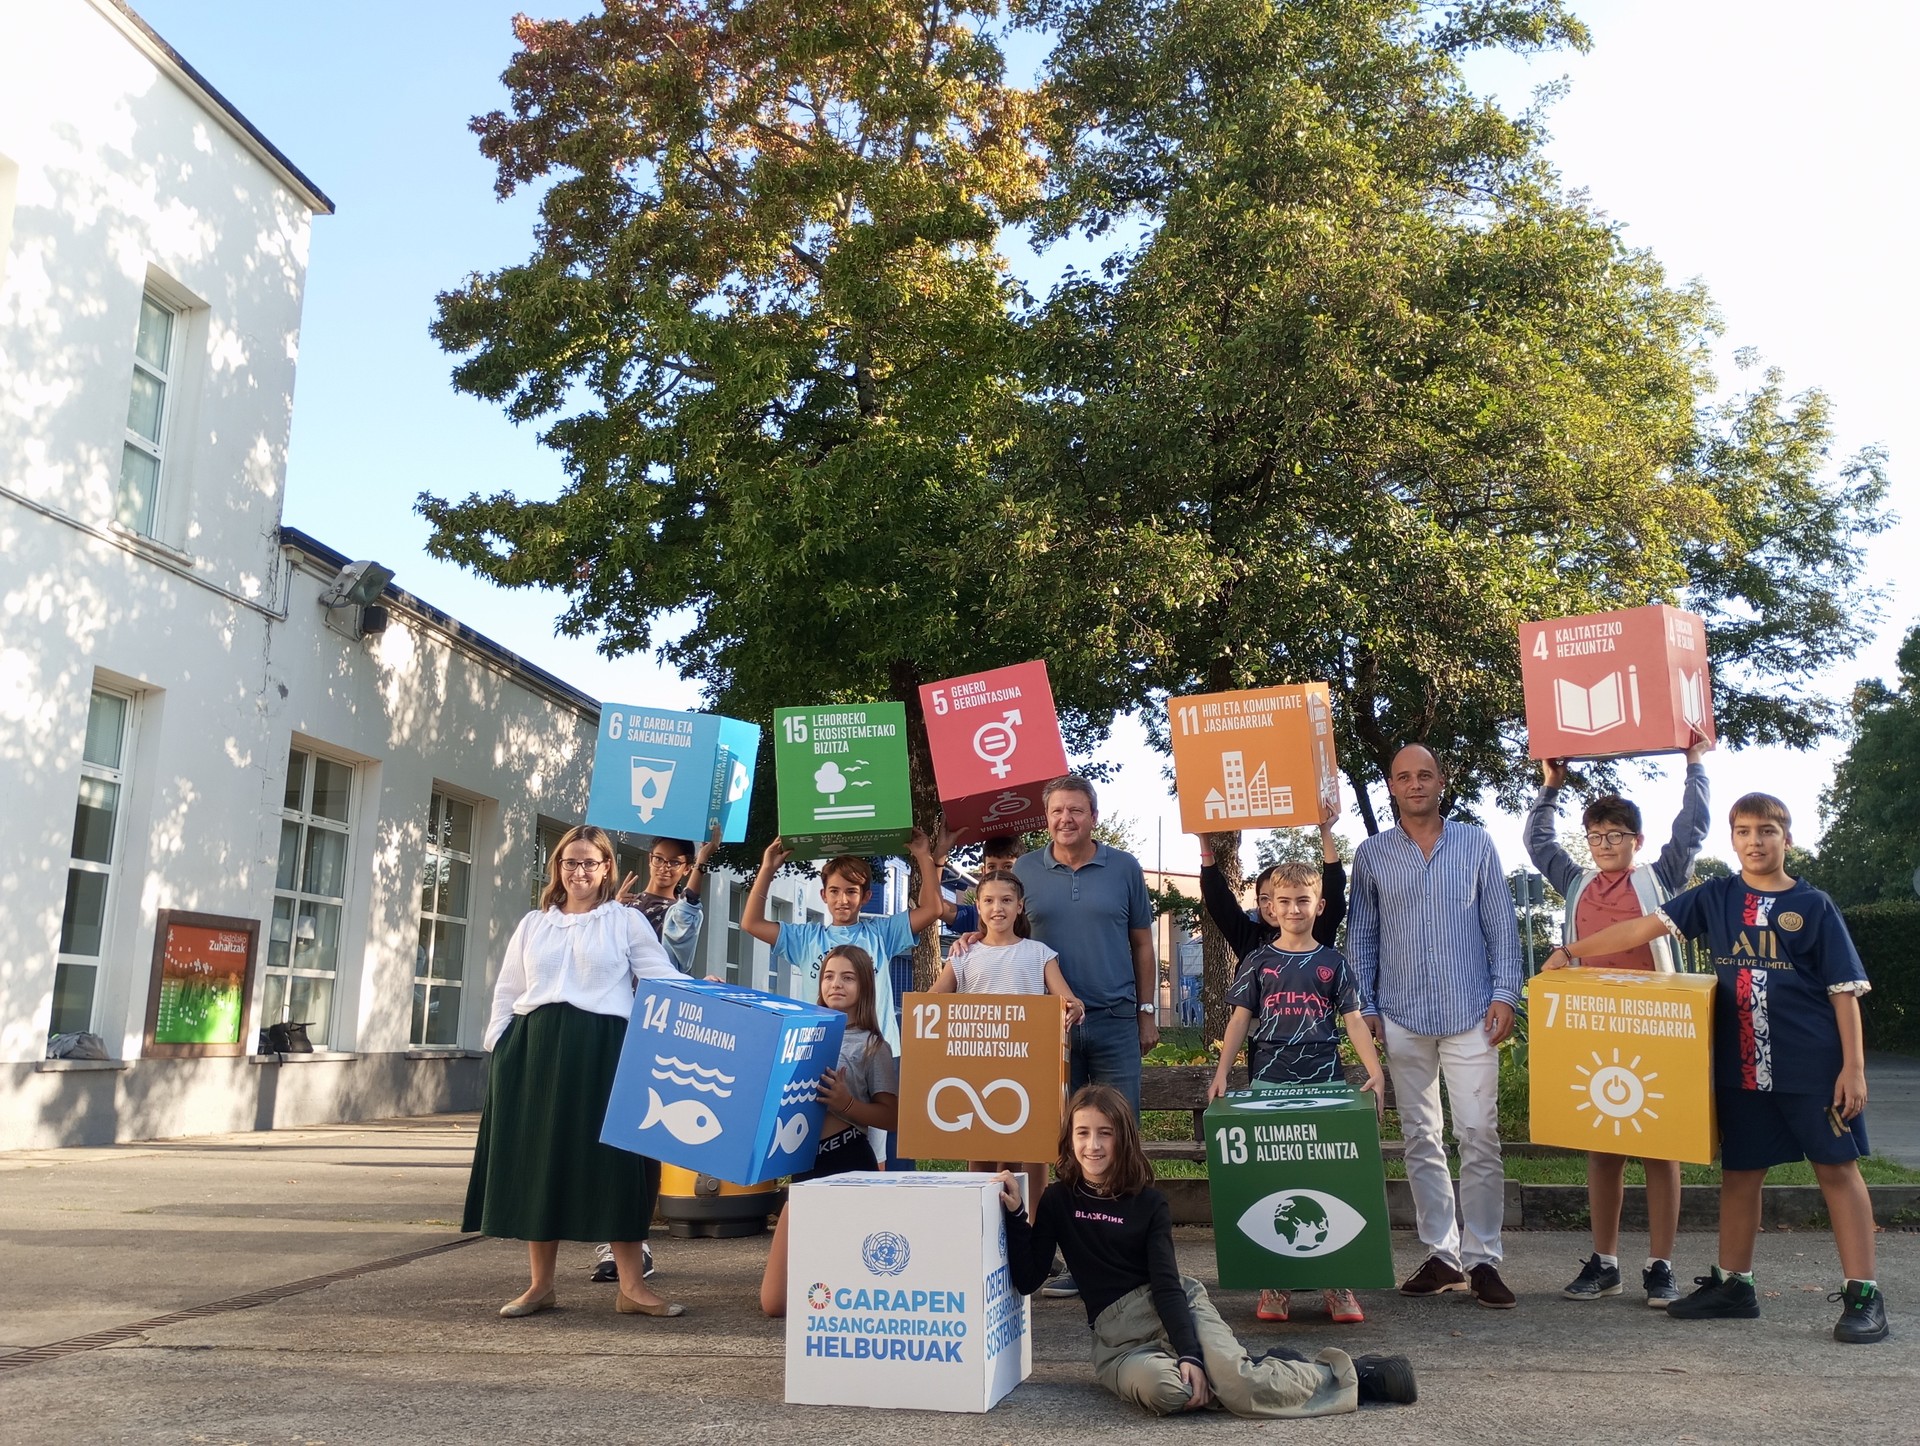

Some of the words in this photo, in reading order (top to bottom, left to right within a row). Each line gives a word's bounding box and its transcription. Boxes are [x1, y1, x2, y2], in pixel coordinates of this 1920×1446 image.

[1555, 621, 1623, 643] KALITATEZKO
[1532, 631, 1549, 660] 4
[1556, 639, 1615, 658] HEZKUNTZA
[951, 680, 987, 698] GENERO
[953, 686, 1022, 711] BERDINTASUNA
[931, 689, 949, 716] 5
[1202, 703, 1221, 718] HIRI
[1224, 702, 1241, 716] ETA
[1243, 695, 1303, 714] KOMUNITATE
[608, 712, 624, 740] 6
[629, 714, 642, 728] UR
[643, 716, 675, 731] GARBIA
[676, 720, 693, 734] ETA
[783, 715, 808, 743] 15
[812, 712, 866, 727] LEHORREKO
[1177, 705, 1200, 736] 11
[1204, 713, 1274, 733] JASANGARRIAK
[627, 728, 692, 748] SANEAMENDUA
[813, 724, 896, 740] EKOSISTEMETAKO
[814, 741, 850, 754] BIZITZA
[789, 836, 813, 844] 15
[1737, 958, 1757, 967] LIVE
[642, 994, 672, 1033] 14
[678, 1001, 704, 1023] VIDA
[948, 1004, 1002, 1021] EKOIZPEN
[1005, 1005, 1026, 1021] ETA
[1273, 1007, 1324, 1018] AIRWAYS
[1543, 992, 1560, 1028] 7
[1565, 994, 1616, 1014] ENERGIA
[1620, 998, 1692, 1020] IRISGARRIA
[912, 1003, 941, 1039] 12
[947, 1022, 1010, 1039] KONTSUMO
[1565, 1012, 1587, 1030] ETA
[1591, 1015, 1605, 1032] EZ
[1609, 1017, 1697, 1039] KUTSAGARRIA
[673, 1019, 736, 1052] SUBMARINA
[781, 1028, 799, 1064] 14
[946, 1040, 1029, 1058] ARDURATSUAK
[1225, 1090, 1253, 1098] 13
[817, 1135, 840, 1155] KE
[843, 1127, 861, 1144] PR
[1253, 1123, 1318, 1143] KLIMAREN
[1215, 1126, 1249, 1165] 13
[1256, 1143, 1303, 1162] ALDEKO
[1307, 1141, 1359, 1160] EKINTZA
[834, 1287, 965, 1314] GARAPEN
[807, 1315, 967, 1338] JASANGARRIRAKO
[986, 1308, 993, 1330] DE
[986, 1309, 1026, 1360] SOSTENIBLE
[806, 1335, 963, 1363] HELBURUAK
